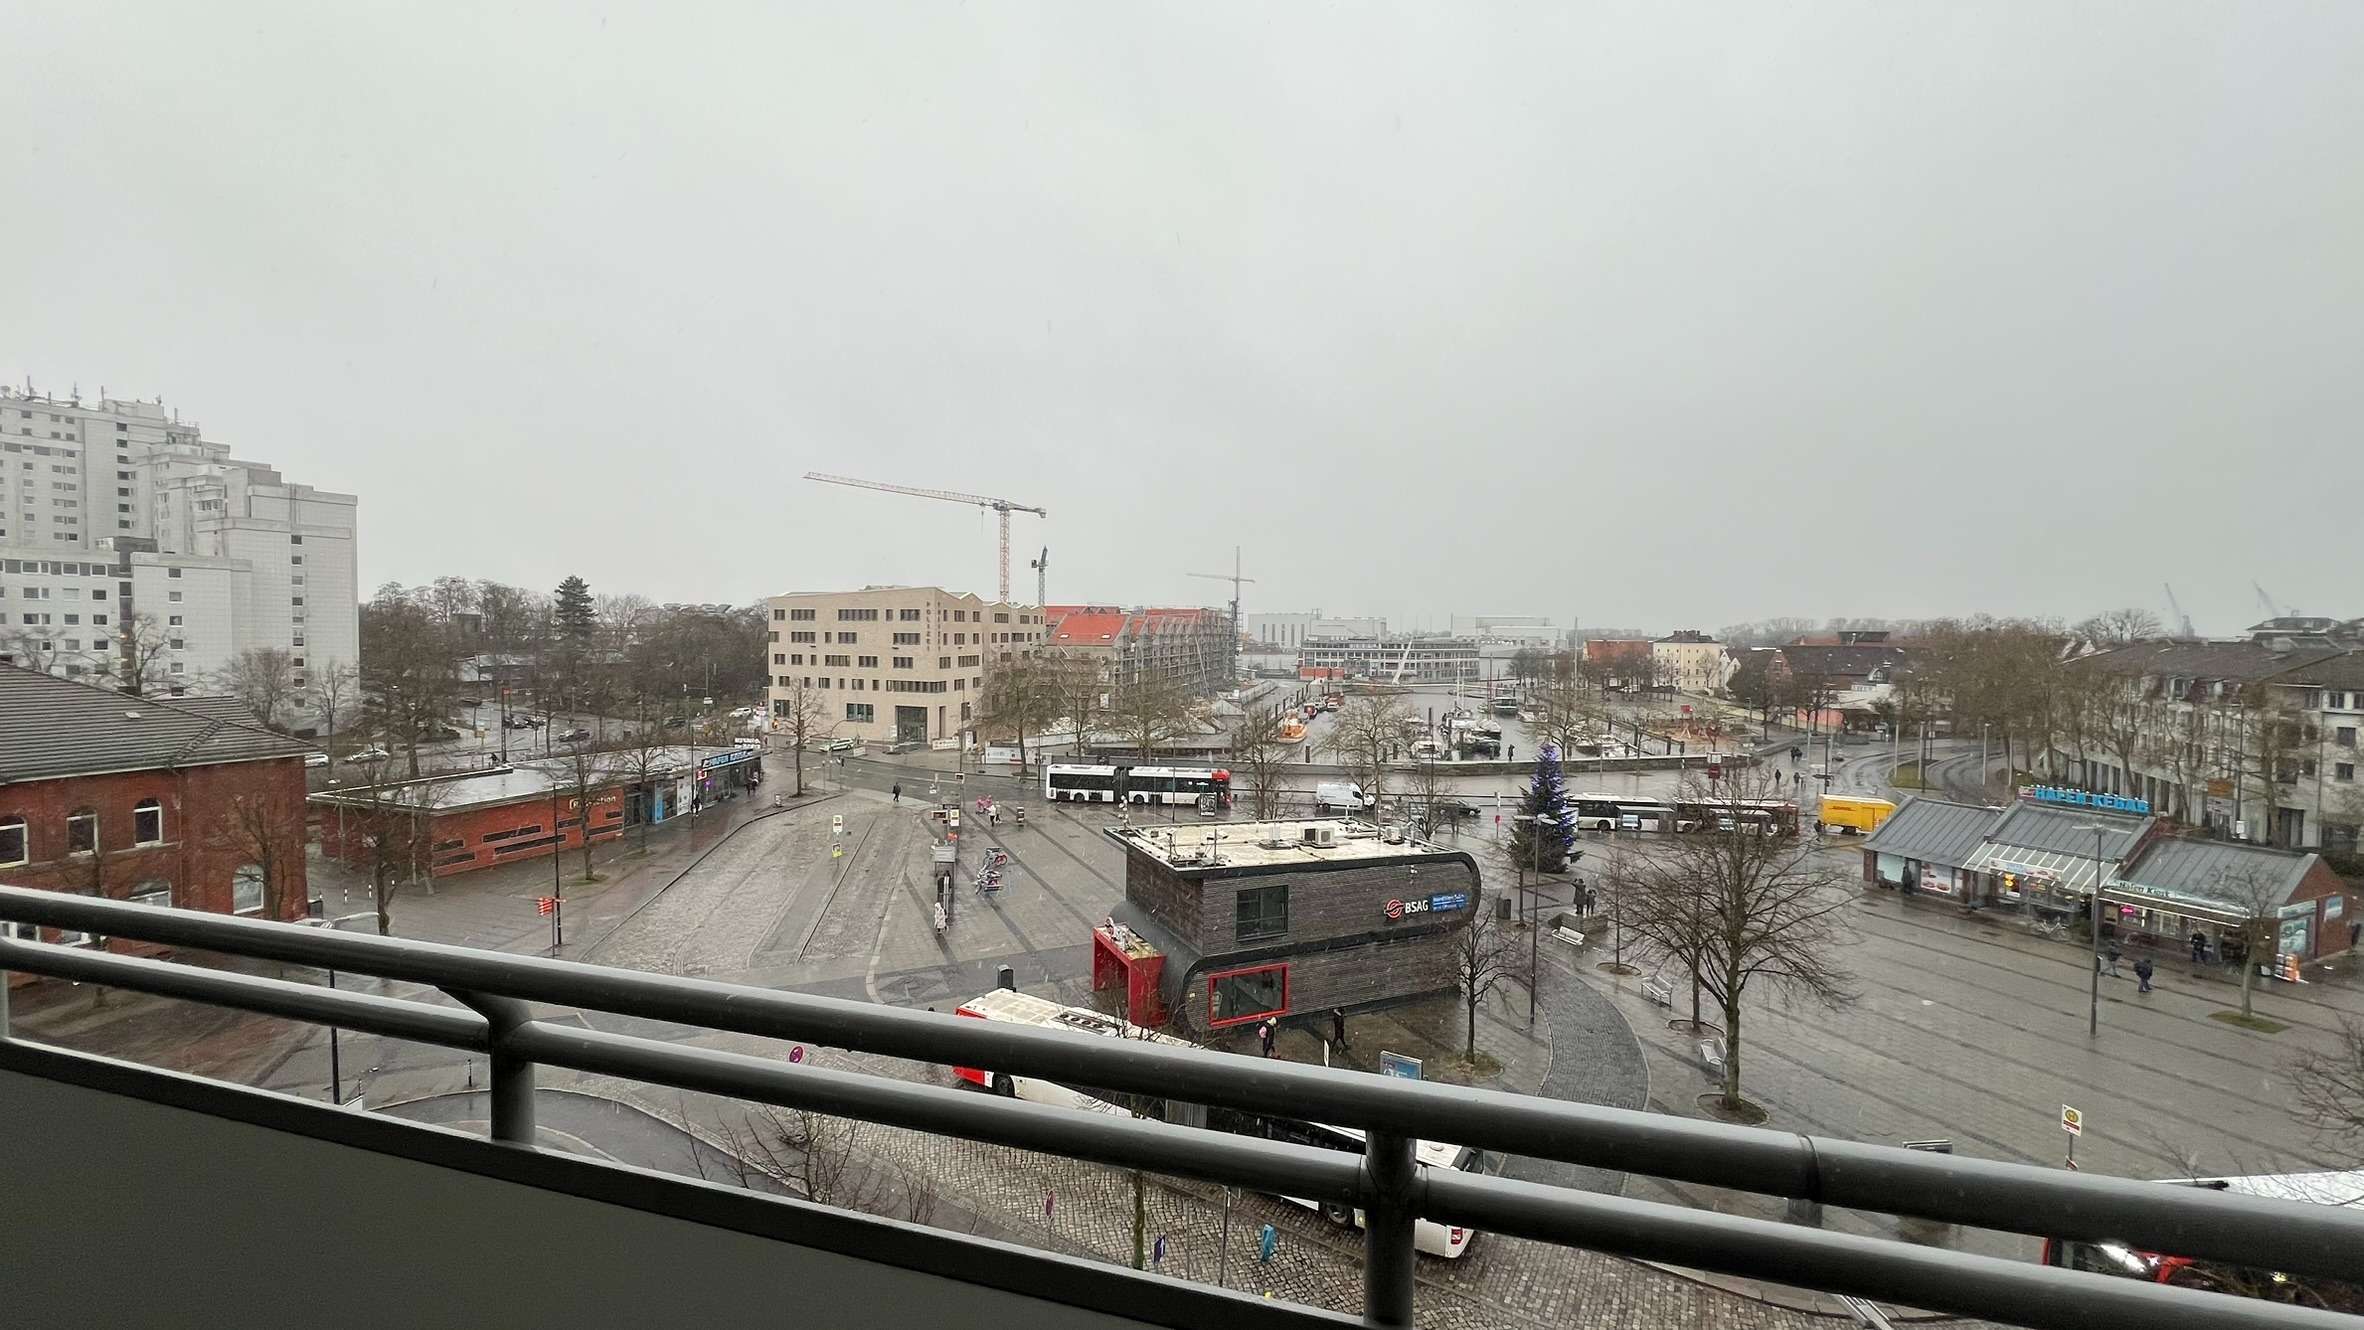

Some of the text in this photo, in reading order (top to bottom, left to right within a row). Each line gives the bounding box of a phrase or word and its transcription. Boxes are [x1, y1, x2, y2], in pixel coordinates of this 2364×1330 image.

[2035, 786, 2150, 814] HAFEN KEBAB
[1405, 900, 1429, 914] BSAG
